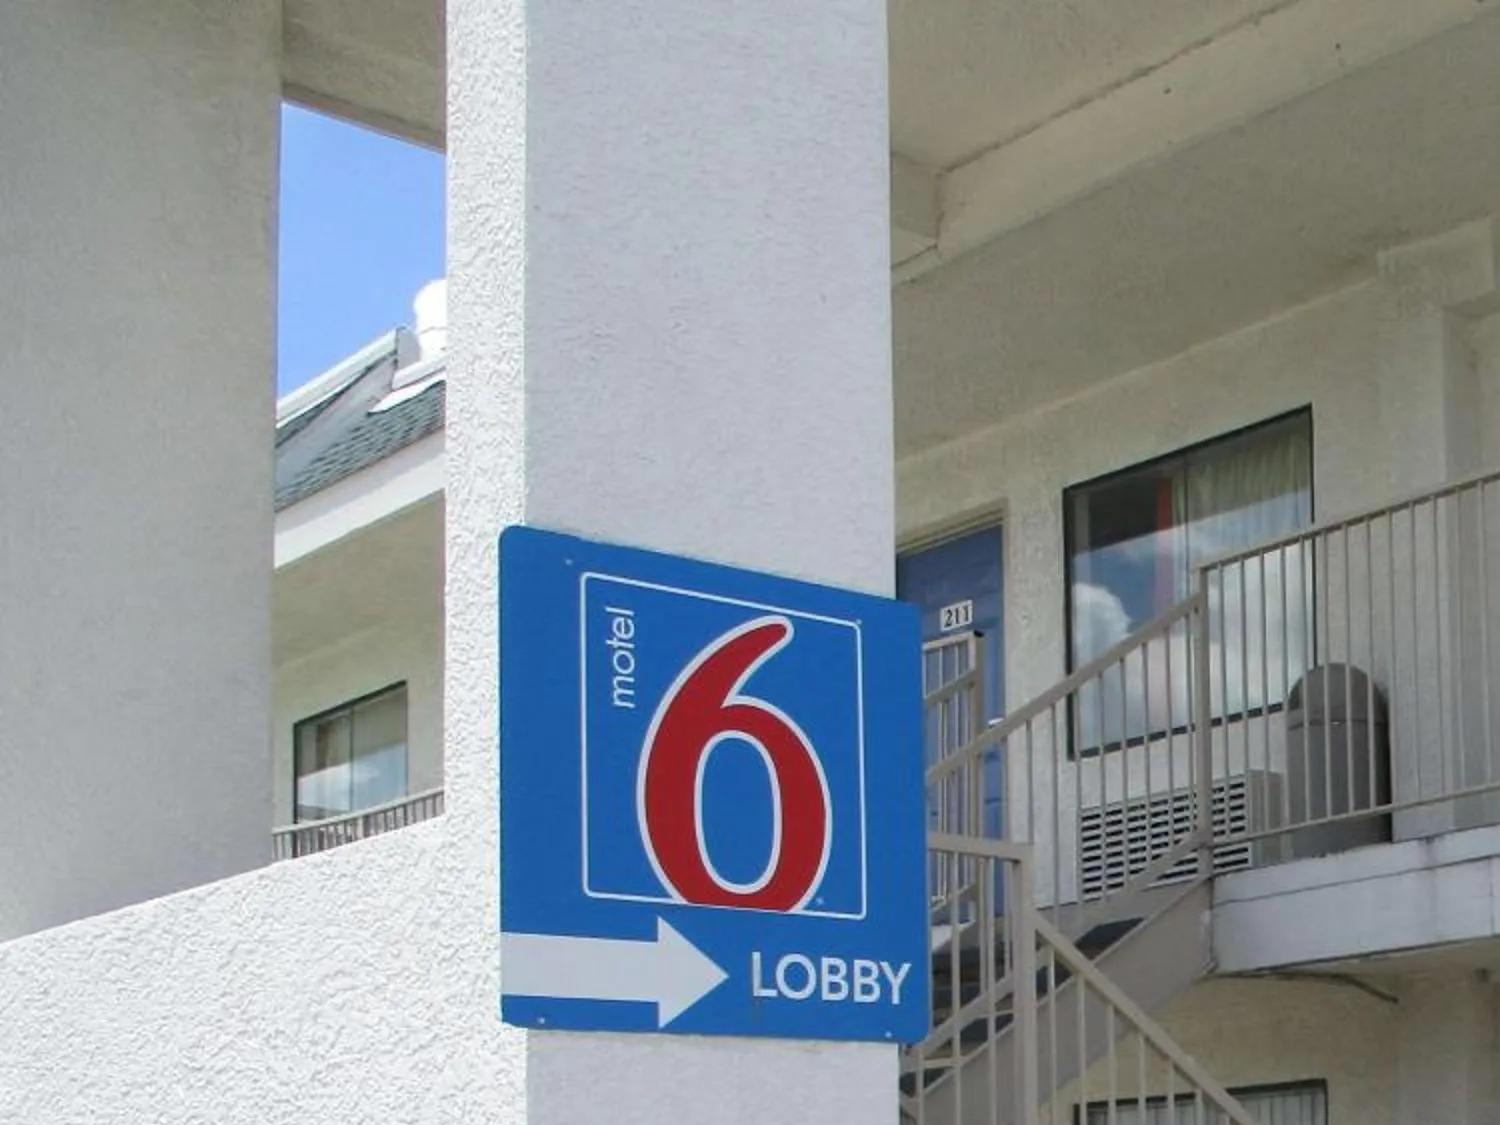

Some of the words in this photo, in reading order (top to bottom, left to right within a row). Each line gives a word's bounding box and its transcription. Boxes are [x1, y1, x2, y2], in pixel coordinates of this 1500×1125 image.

[943, 603, 970, 628] 211
[605, 606, 636, 708] motel
[636, 614, 832, 913] 6
[750, 951, 912, 1005] LOBBY
